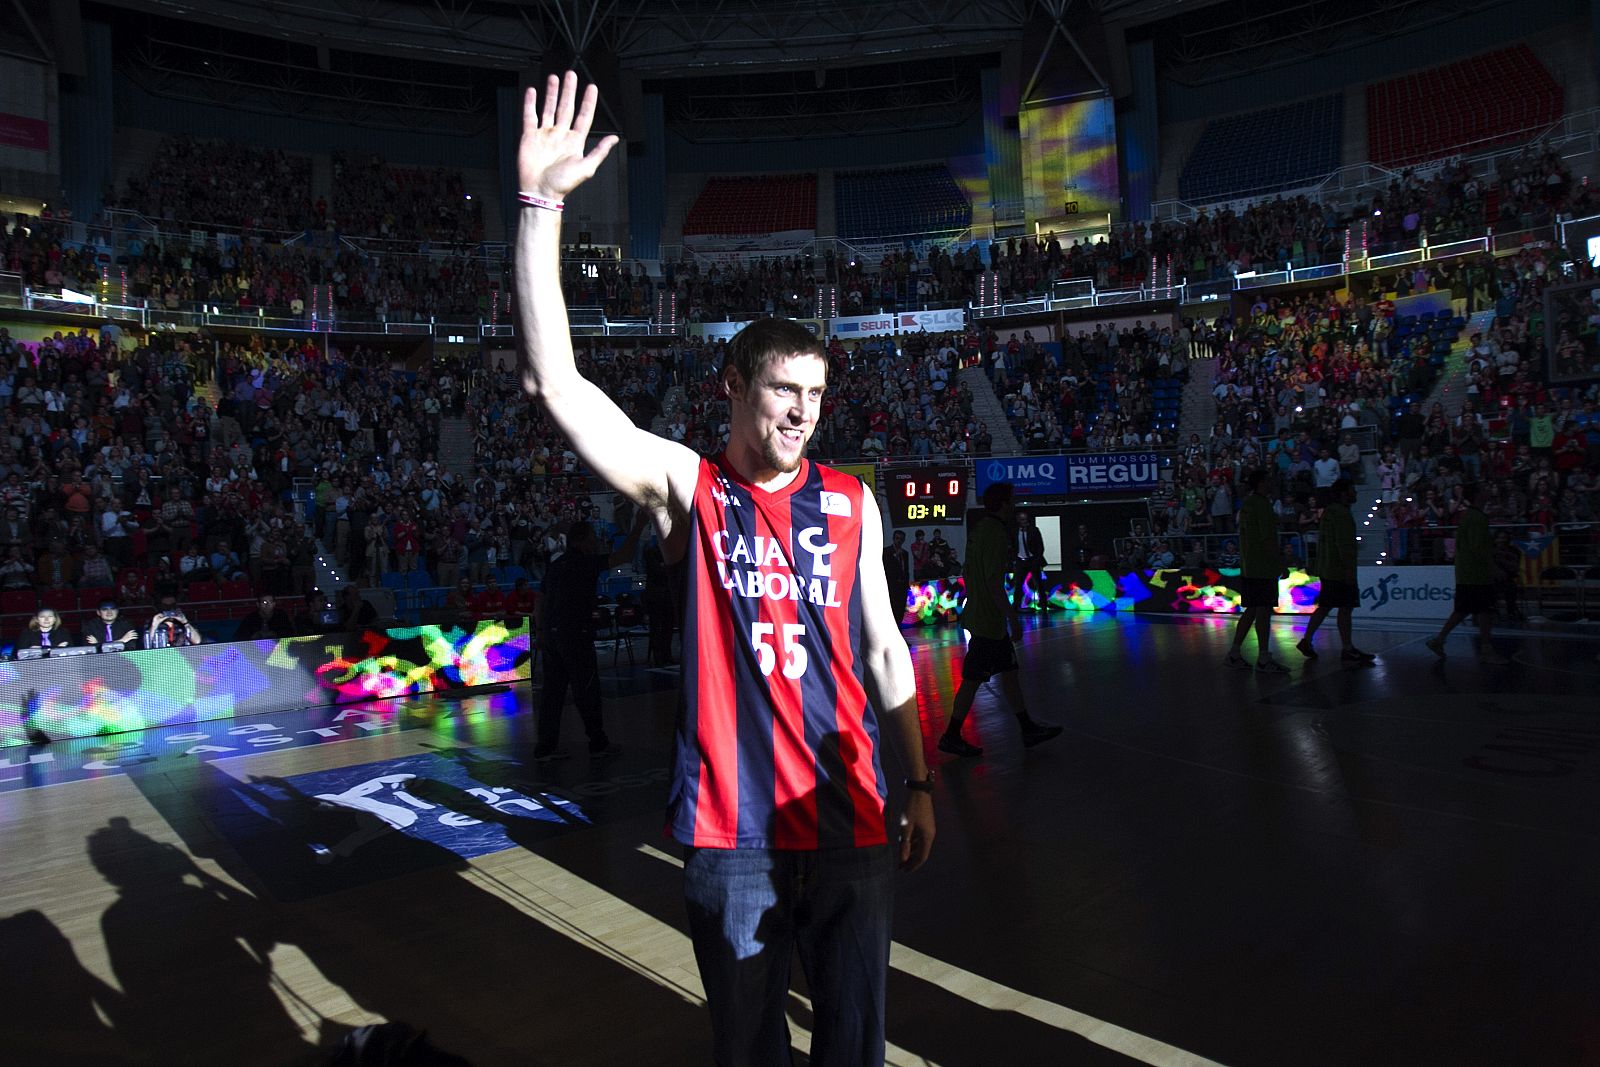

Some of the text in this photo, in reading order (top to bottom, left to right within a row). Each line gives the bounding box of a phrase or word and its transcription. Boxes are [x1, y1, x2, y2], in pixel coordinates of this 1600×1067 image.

[1066, 203, 1077, 213] 10
[861, 320, 891, 331] SEUR
[919, 312, 960, 325] SLK
[1069, 454, 1158, 465] LUMINOSOS
[1007, 463, 1056, 480] IMQ
[1069, 463, 1158, 484] REGUI
[907, 504, 946, 520] 03:14
[713, 530, 789, 566] CAJA
[717, 561, 842, 608] LABORAL
[1391, 583, 1455, 601] endes
[751, 621, 808, 680] 55
